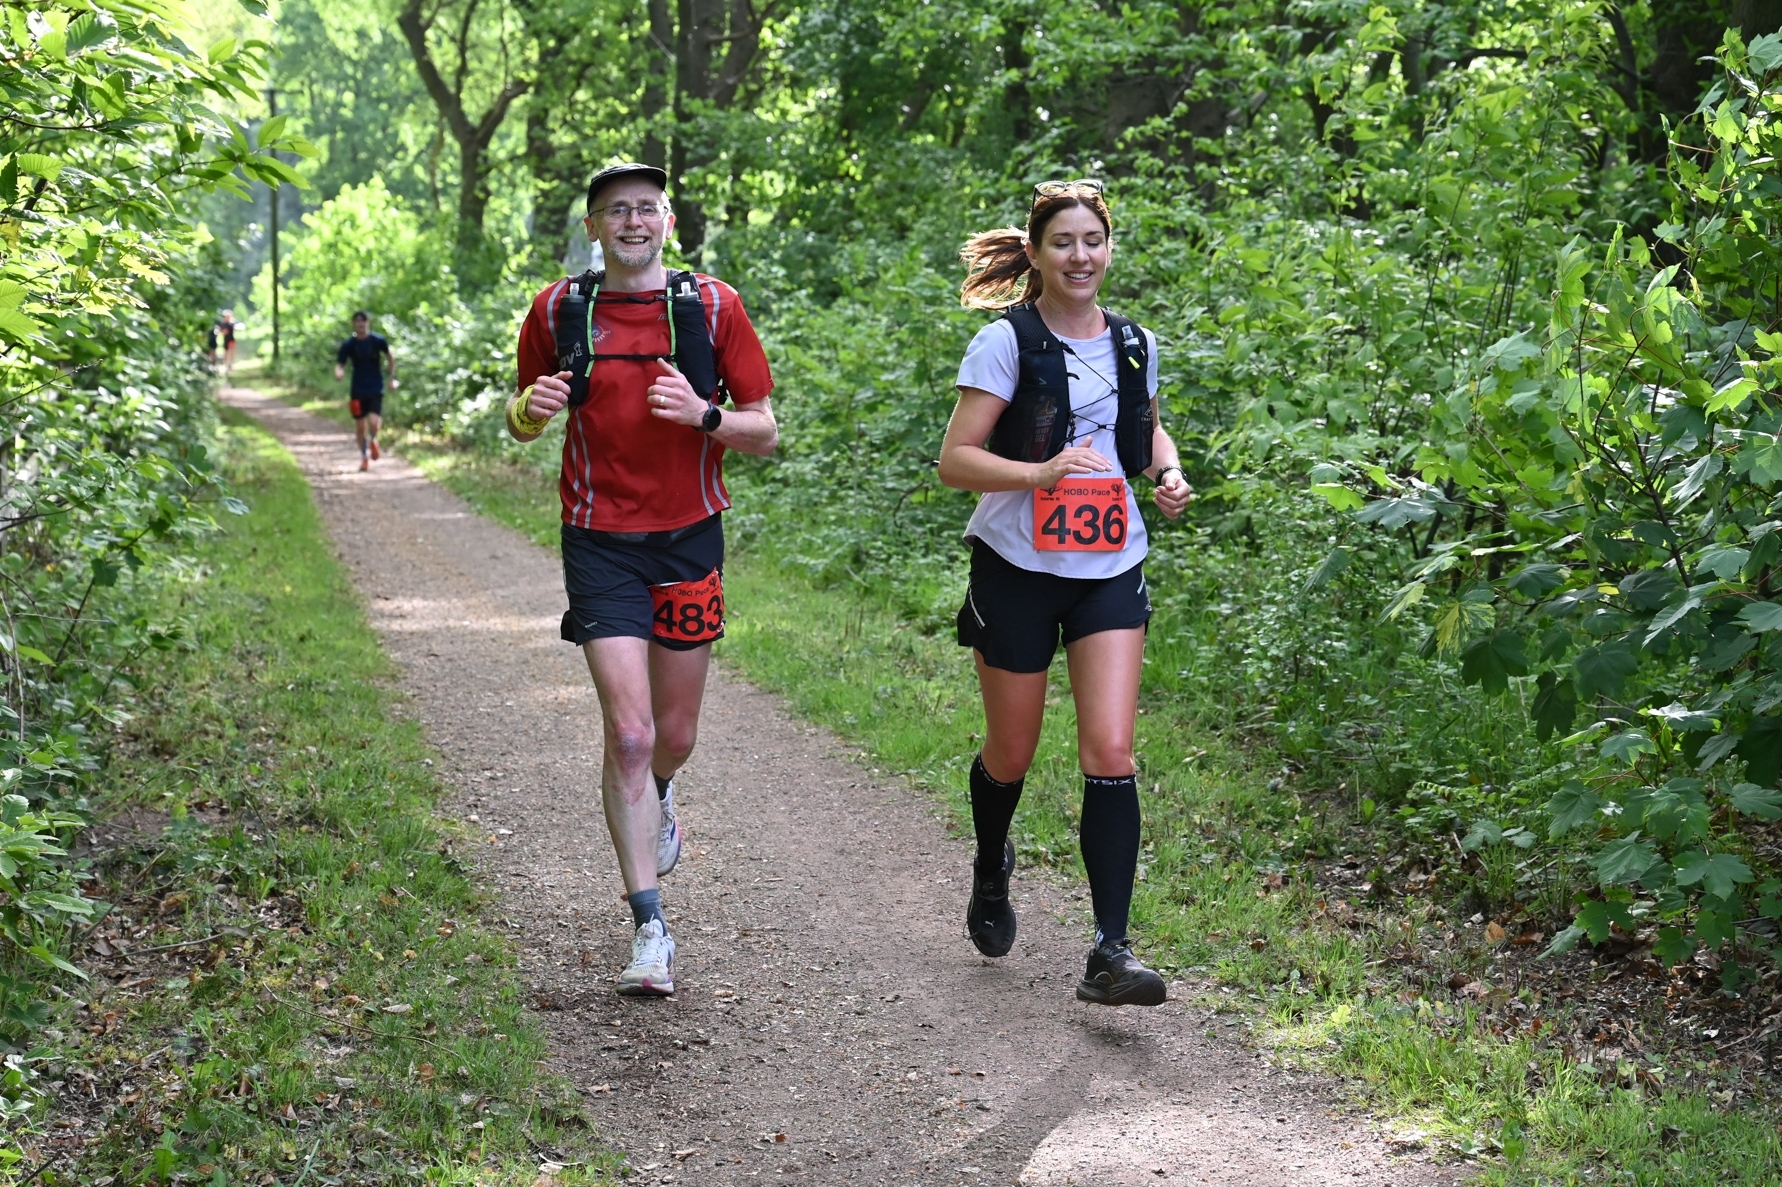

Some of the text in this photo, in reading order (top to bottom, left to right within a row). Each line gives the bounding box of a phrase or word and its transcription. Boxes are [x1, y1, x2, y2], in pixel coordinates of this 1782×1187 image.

[1034, 434, 1045, 443] GEL
[1063, 488, 1111, 496] HOBO Pace
[1042, 504, 1124, 545] 436
[672, 587, 692, 596] HOBO
[695, 587, 709, 596] Pace
[653, 595, 723, 636] 483
